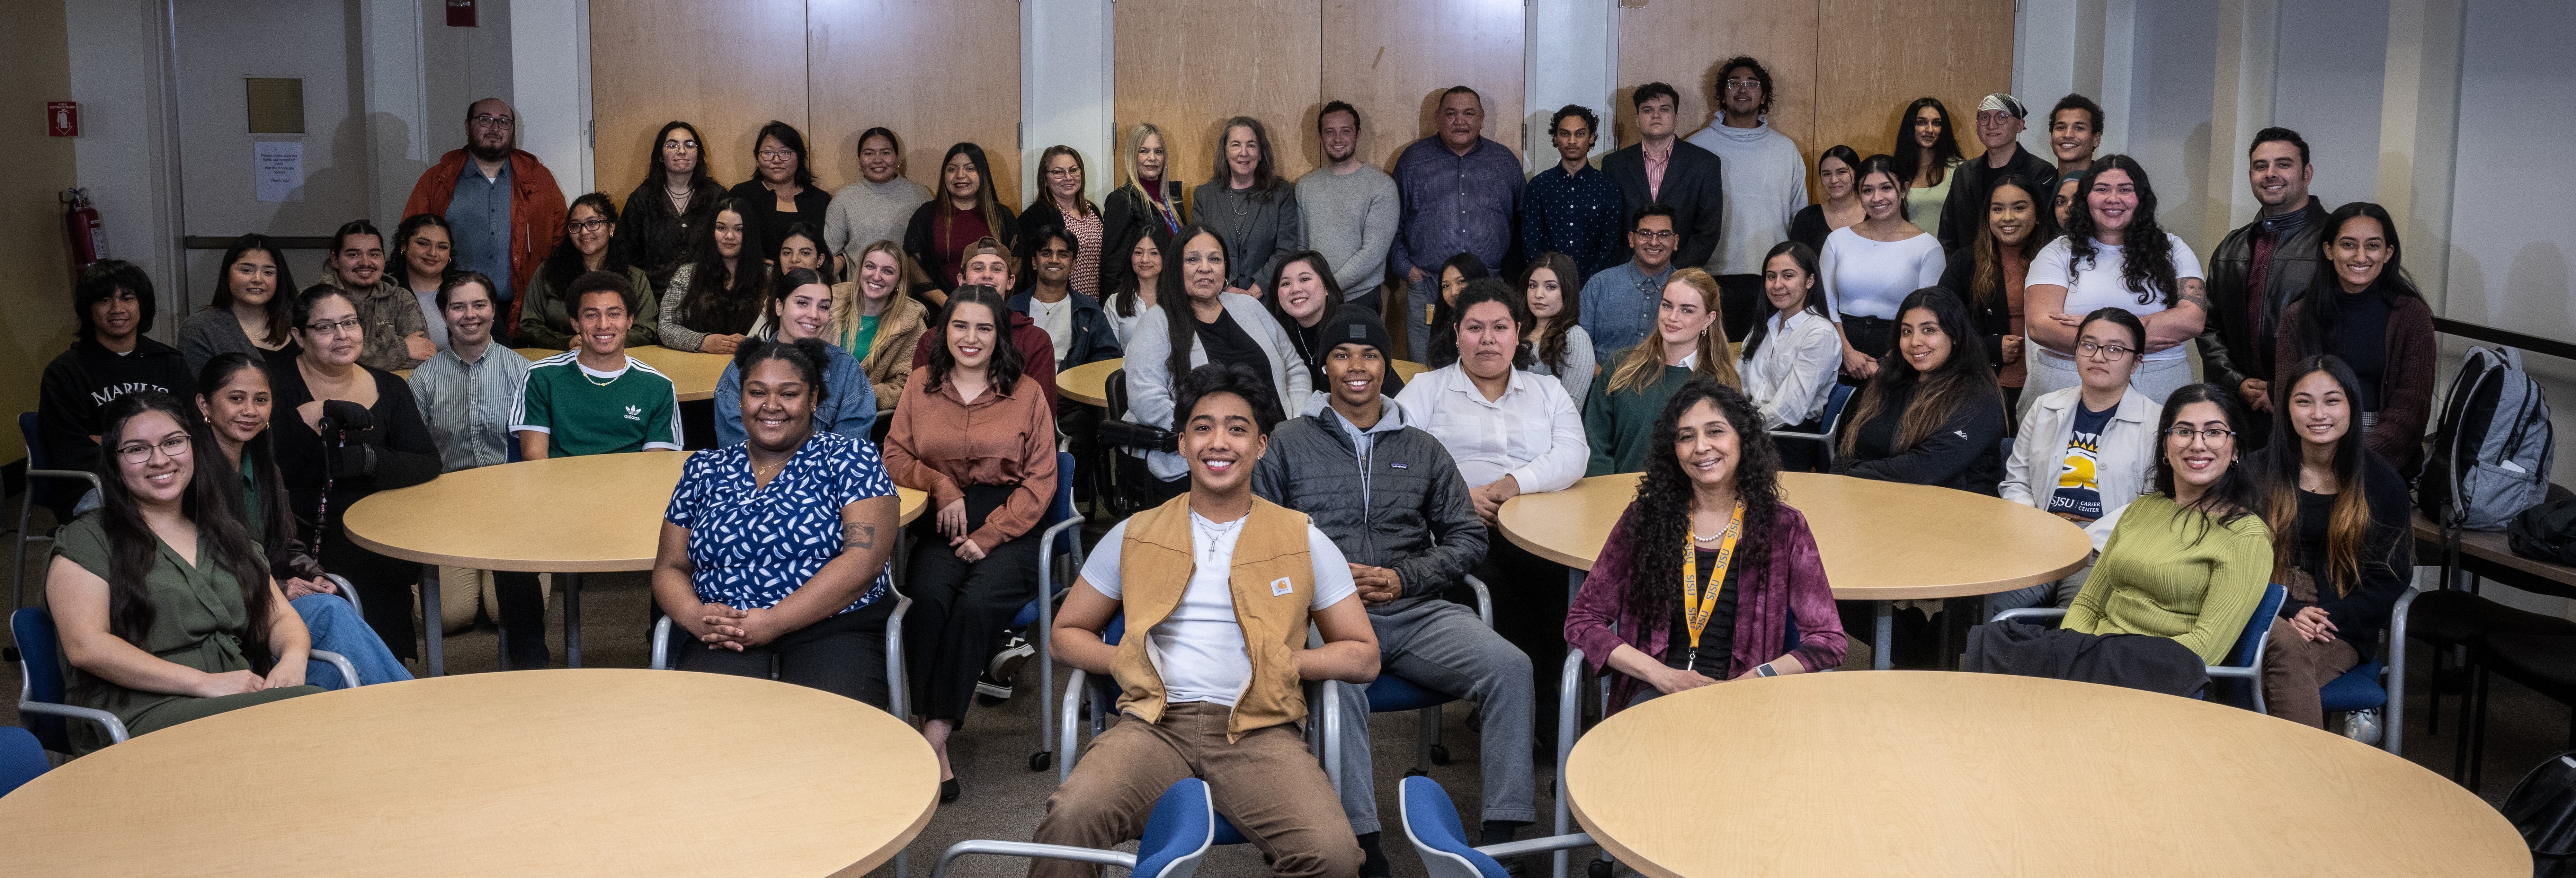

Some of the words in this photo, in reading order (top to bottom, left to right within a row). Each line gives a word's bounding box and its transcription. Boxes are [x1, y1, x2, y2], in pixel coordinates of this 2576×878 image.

[2050, 496, 2075, 507] SJSU
[1727, 518, 1740, 540] SJSU
[1685, 542, 1693, 563] SJSU
[1717, 548, 1729, 570] SJSU
[1685, 575, 1695, 595] SJSU
[1706, 579, 1719, 601] SJSU
[1687, 607, 1696, 628] SJSU
[1695, 610, 1708, 630] SJSU
